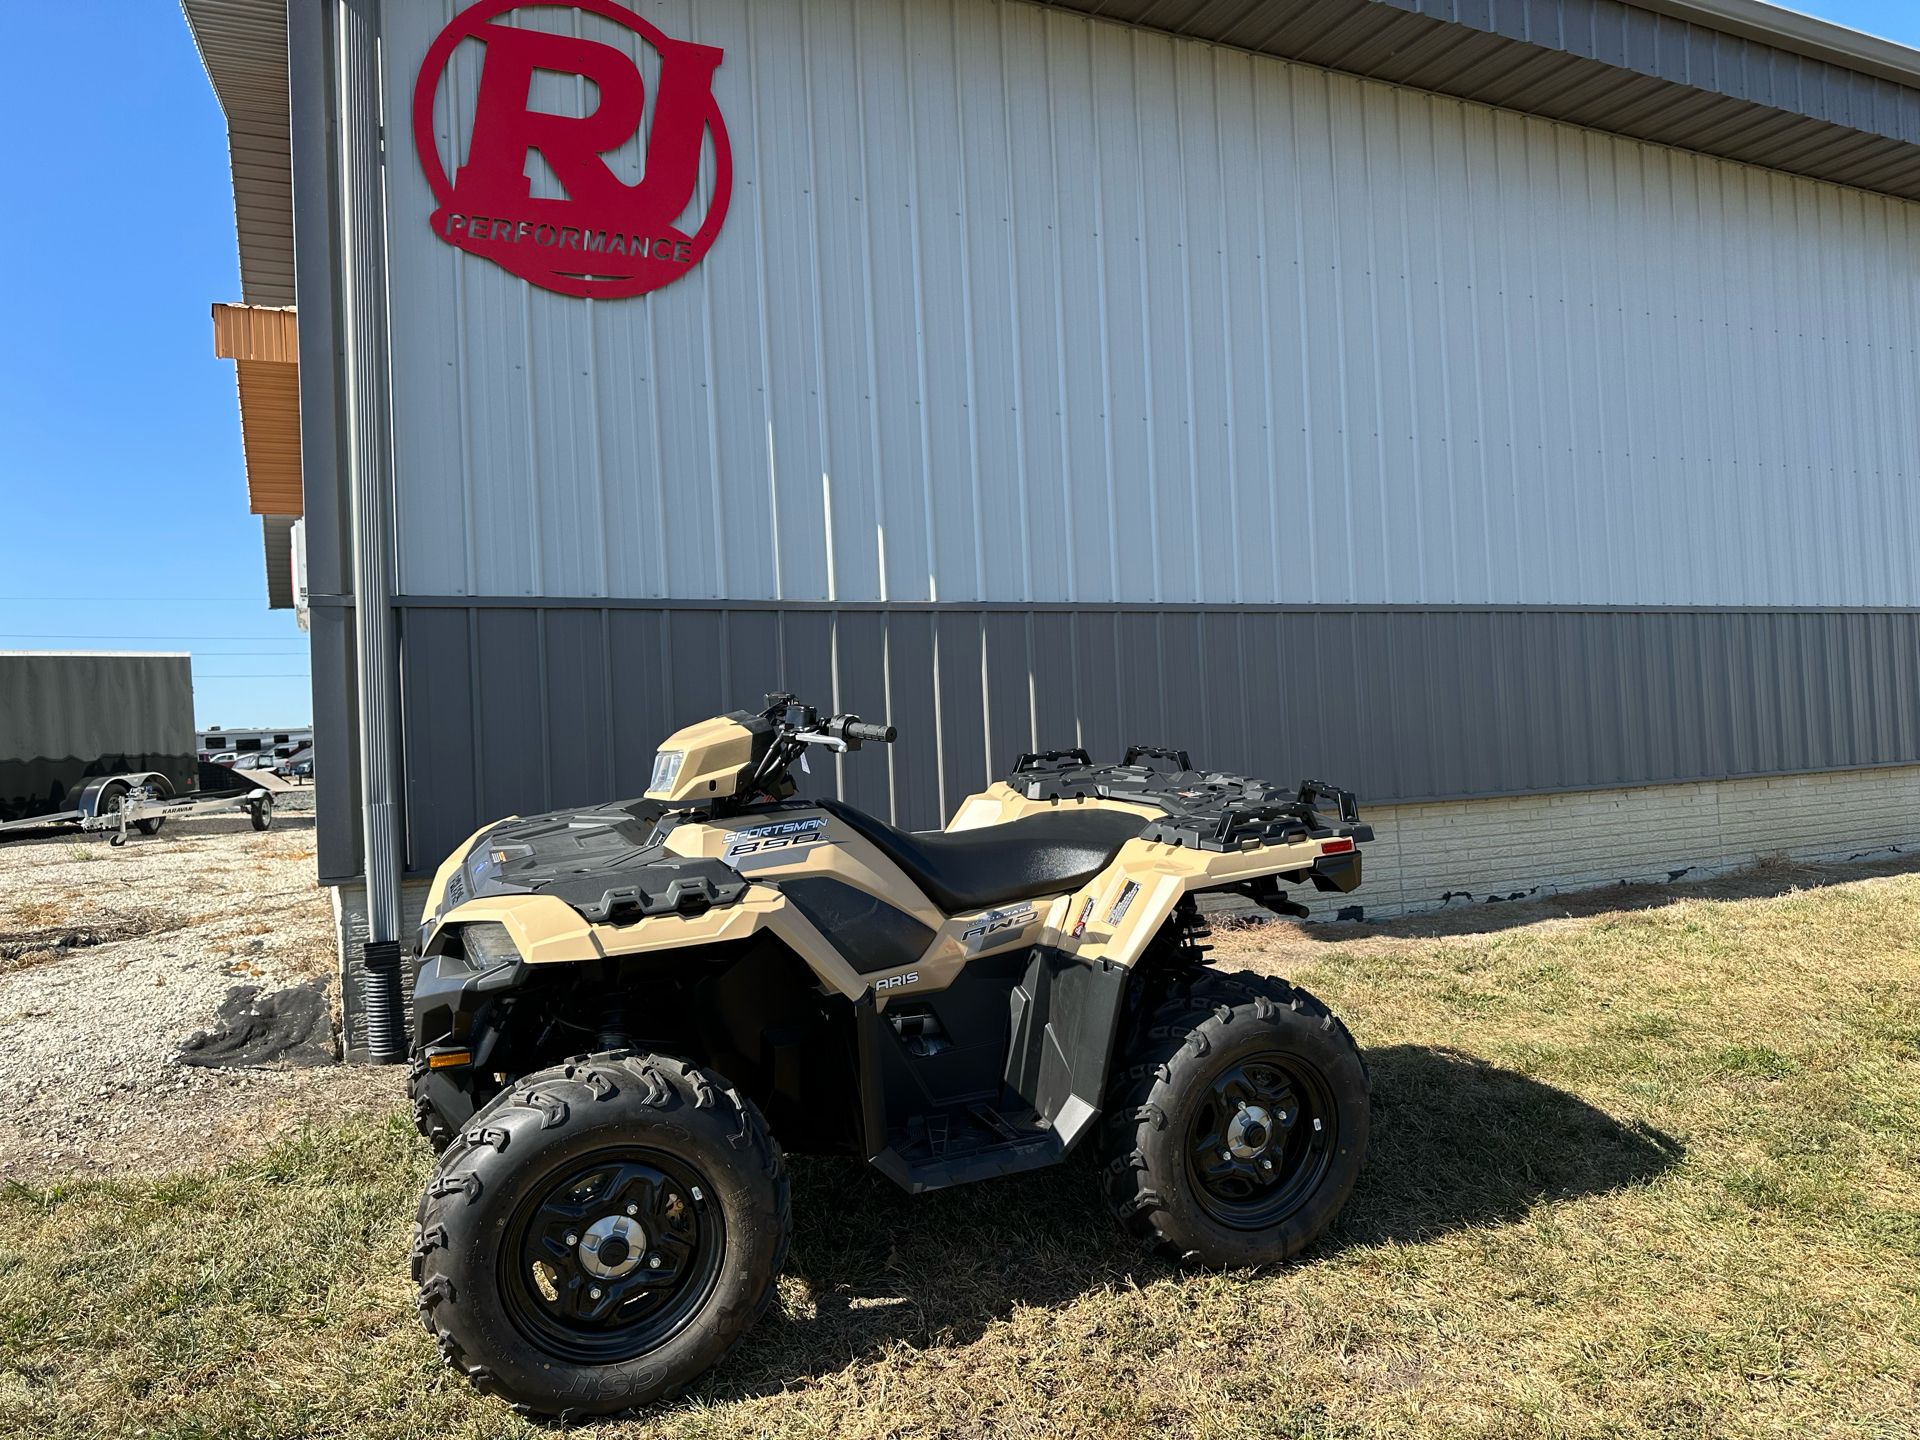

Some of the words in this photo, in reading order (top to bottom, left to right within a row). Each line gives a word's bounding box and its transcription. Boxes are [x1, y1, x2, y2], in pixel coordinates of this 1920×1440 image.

[453, 24, 724, 216] RJ
[445, 213, 692, 263] PERFORMANCE
[162, 806, 193, 814] KARAVAN
[722, 818, 828, 845] SPORTSMAN
[729, 832, 822, 857] 850
[961, 911, 1039, 941] AWD
